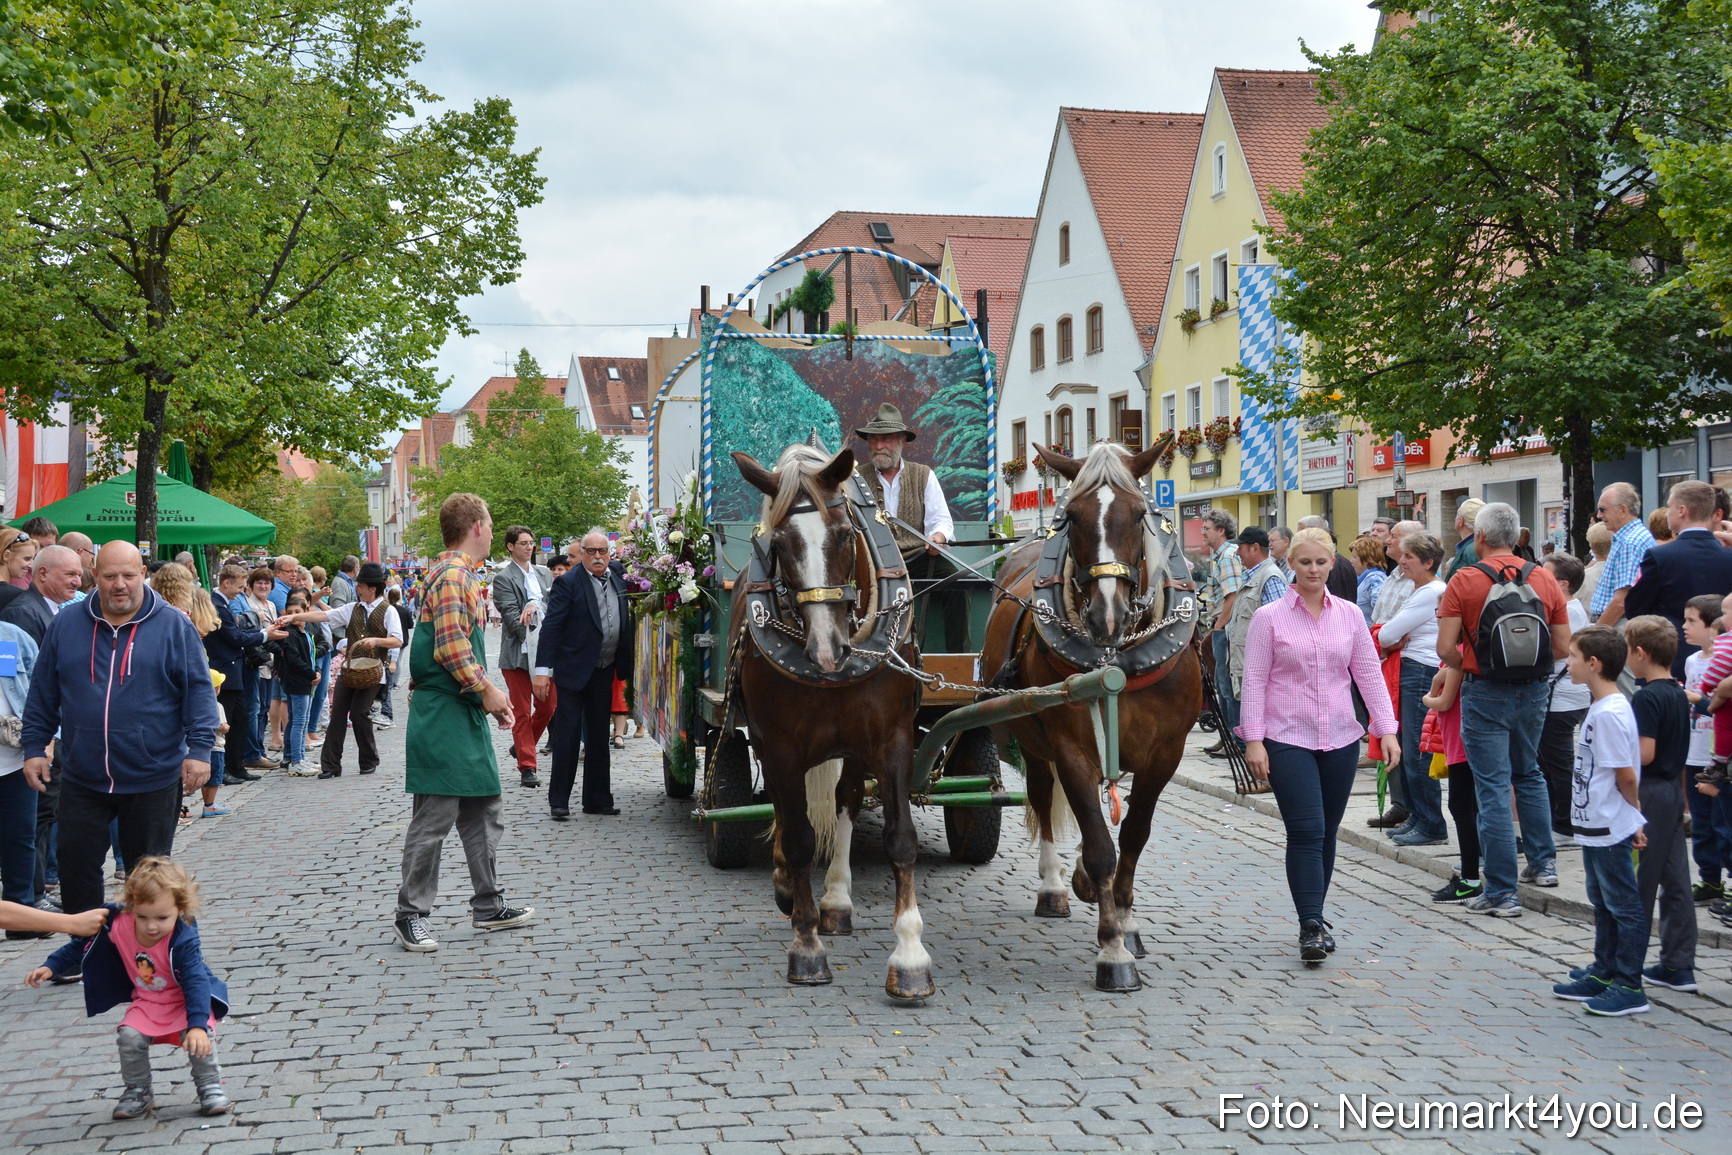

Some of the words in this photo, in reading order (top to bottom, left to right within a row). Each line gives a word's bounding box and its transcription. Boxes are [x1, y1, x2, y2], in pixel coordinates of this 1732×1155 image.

[1404, 445, 1424, 455] DER
[1326, 456, 1337, 467] KINO
[1346, 433, 1354, 484] KINO
[1160, 483, 1170, 505] P
